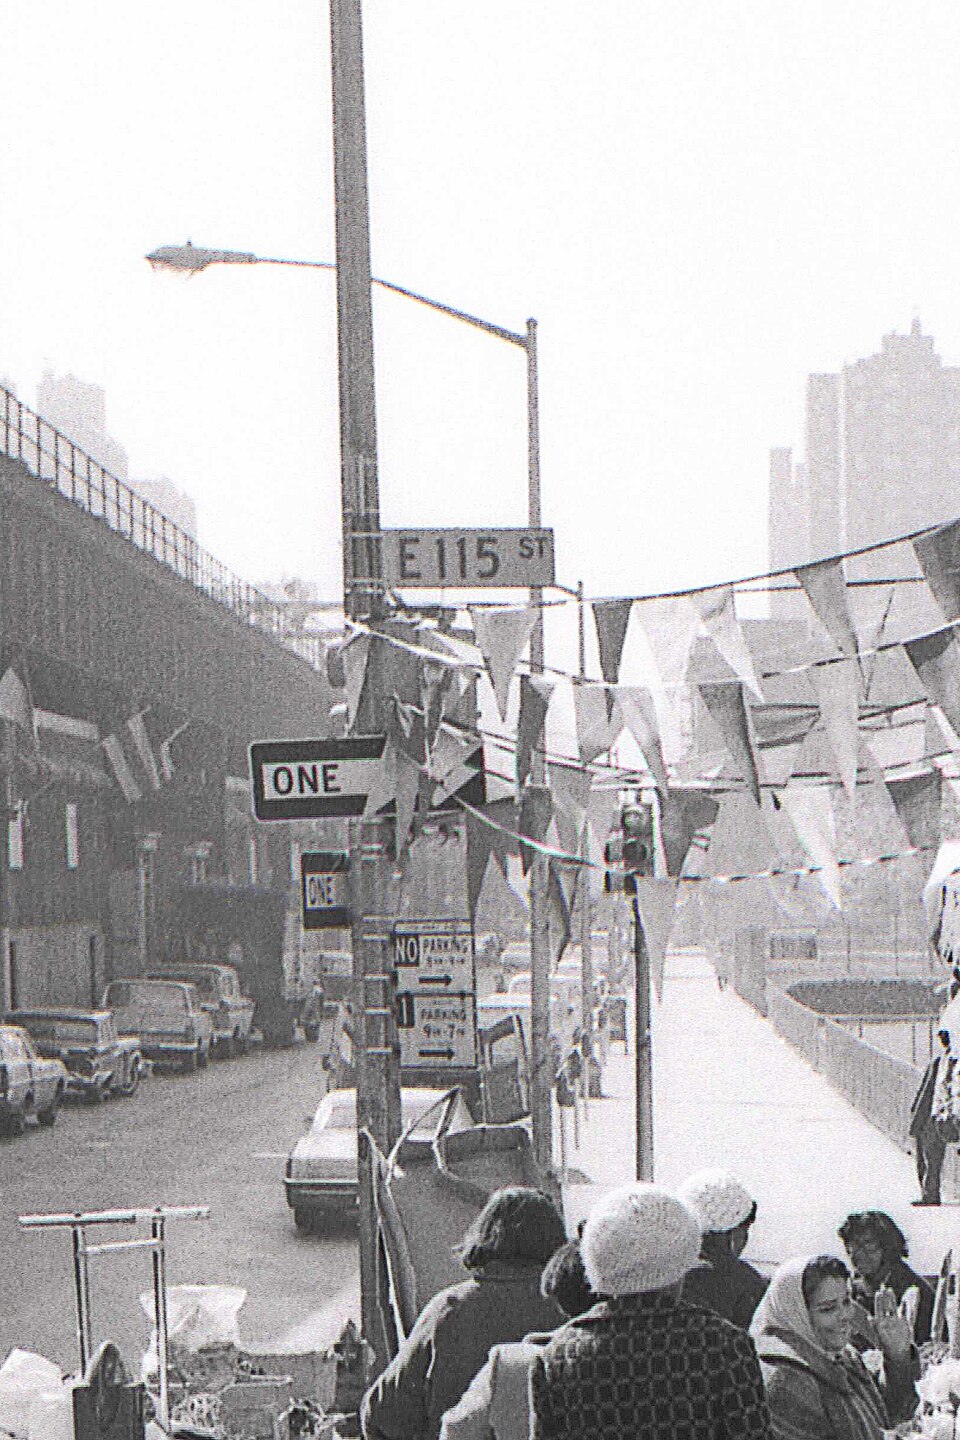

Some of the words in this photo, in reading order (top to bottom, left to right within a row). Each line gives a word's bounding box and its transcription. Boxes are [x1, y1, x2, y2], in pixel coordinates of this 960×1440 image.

[434, 536, 500, 580] 115
[517, 536, 549, 559] ST
[273, 763, 342, 795] ONE
[308, 875, 334, 905] ONE
[396, 936, 418, 962] NO
